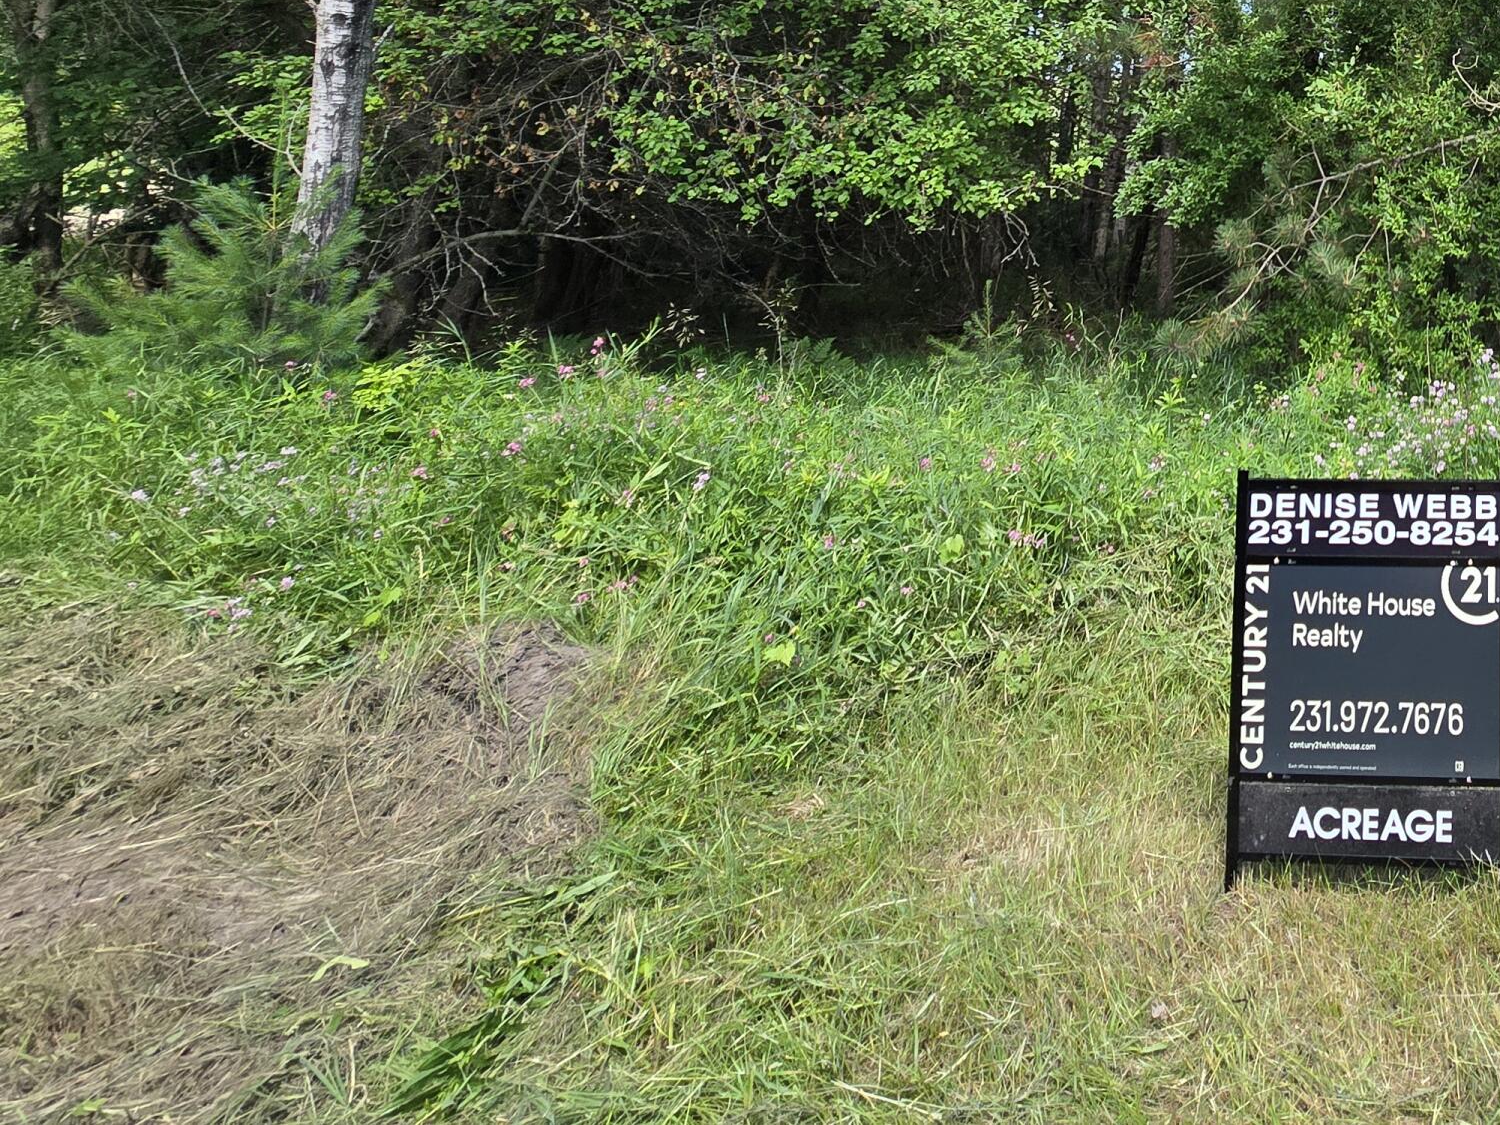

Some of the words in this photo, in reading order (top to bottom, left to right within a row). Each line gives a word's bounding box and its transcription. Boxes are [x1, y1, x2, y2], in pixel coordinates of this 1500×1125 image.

[1250, 493, 1380, 518] DENISE
[1393, 494, 1497, 520] WEBB
[1248, 520, 1499, 546] 231-250-8254
[1245, 564, 1270, 594] 21
[1293, 590, 1362, 615] White
[1367, 592, 1436, 616] House
[1292, 623, 1363, 653] Realty
[1239, 601, 1268, 770] CENTURY
[1289, 700, 1464, 735] 231.972.7676
[1289, 741, 1376, 751] century21whitehouse.com
[1288, 806, 1453, 843] ACREAGE
